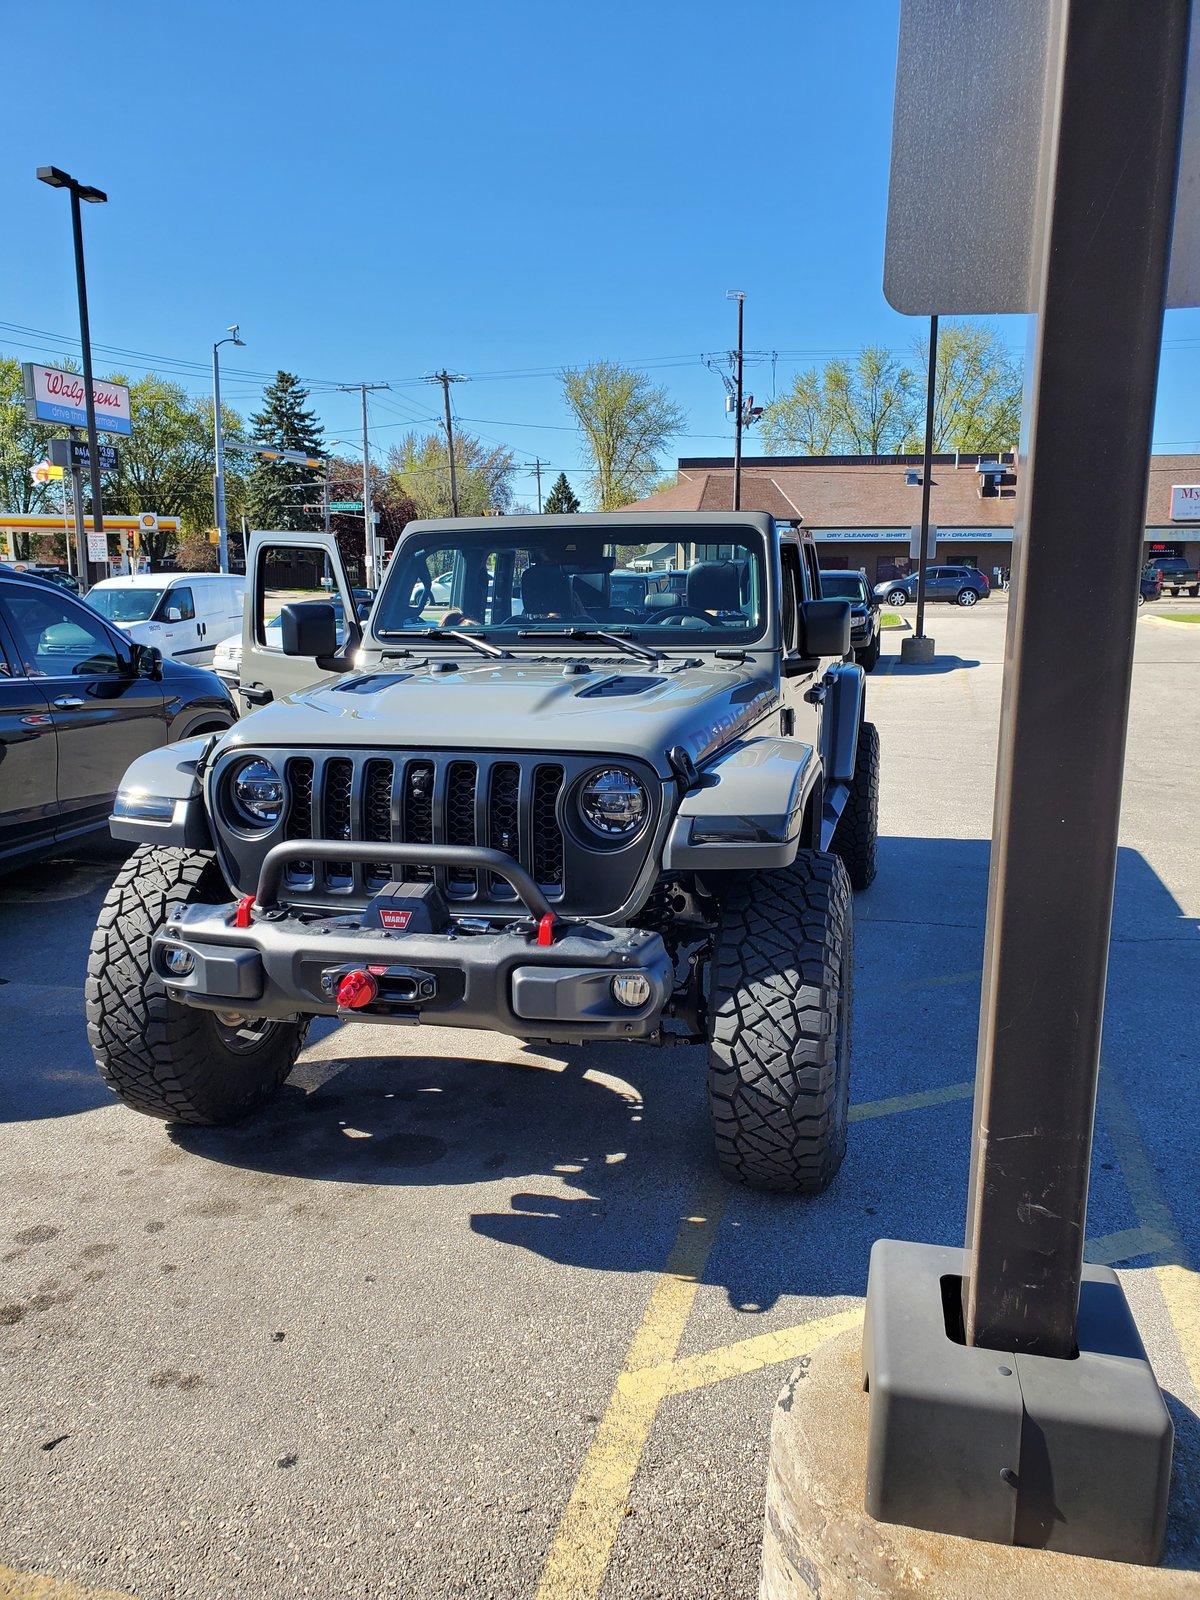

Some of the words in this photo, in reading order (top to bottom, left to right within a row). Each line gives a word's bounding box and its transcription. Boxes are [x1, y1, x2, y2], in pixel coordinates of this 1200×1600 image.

[44, 372, 121, 407] Walgeens
[51, 406, 70, 418] drive
[71, 411, 85, 421] thru
[94, 416, 119, 430] armacy
[384, 915, 406, 923] WARN
